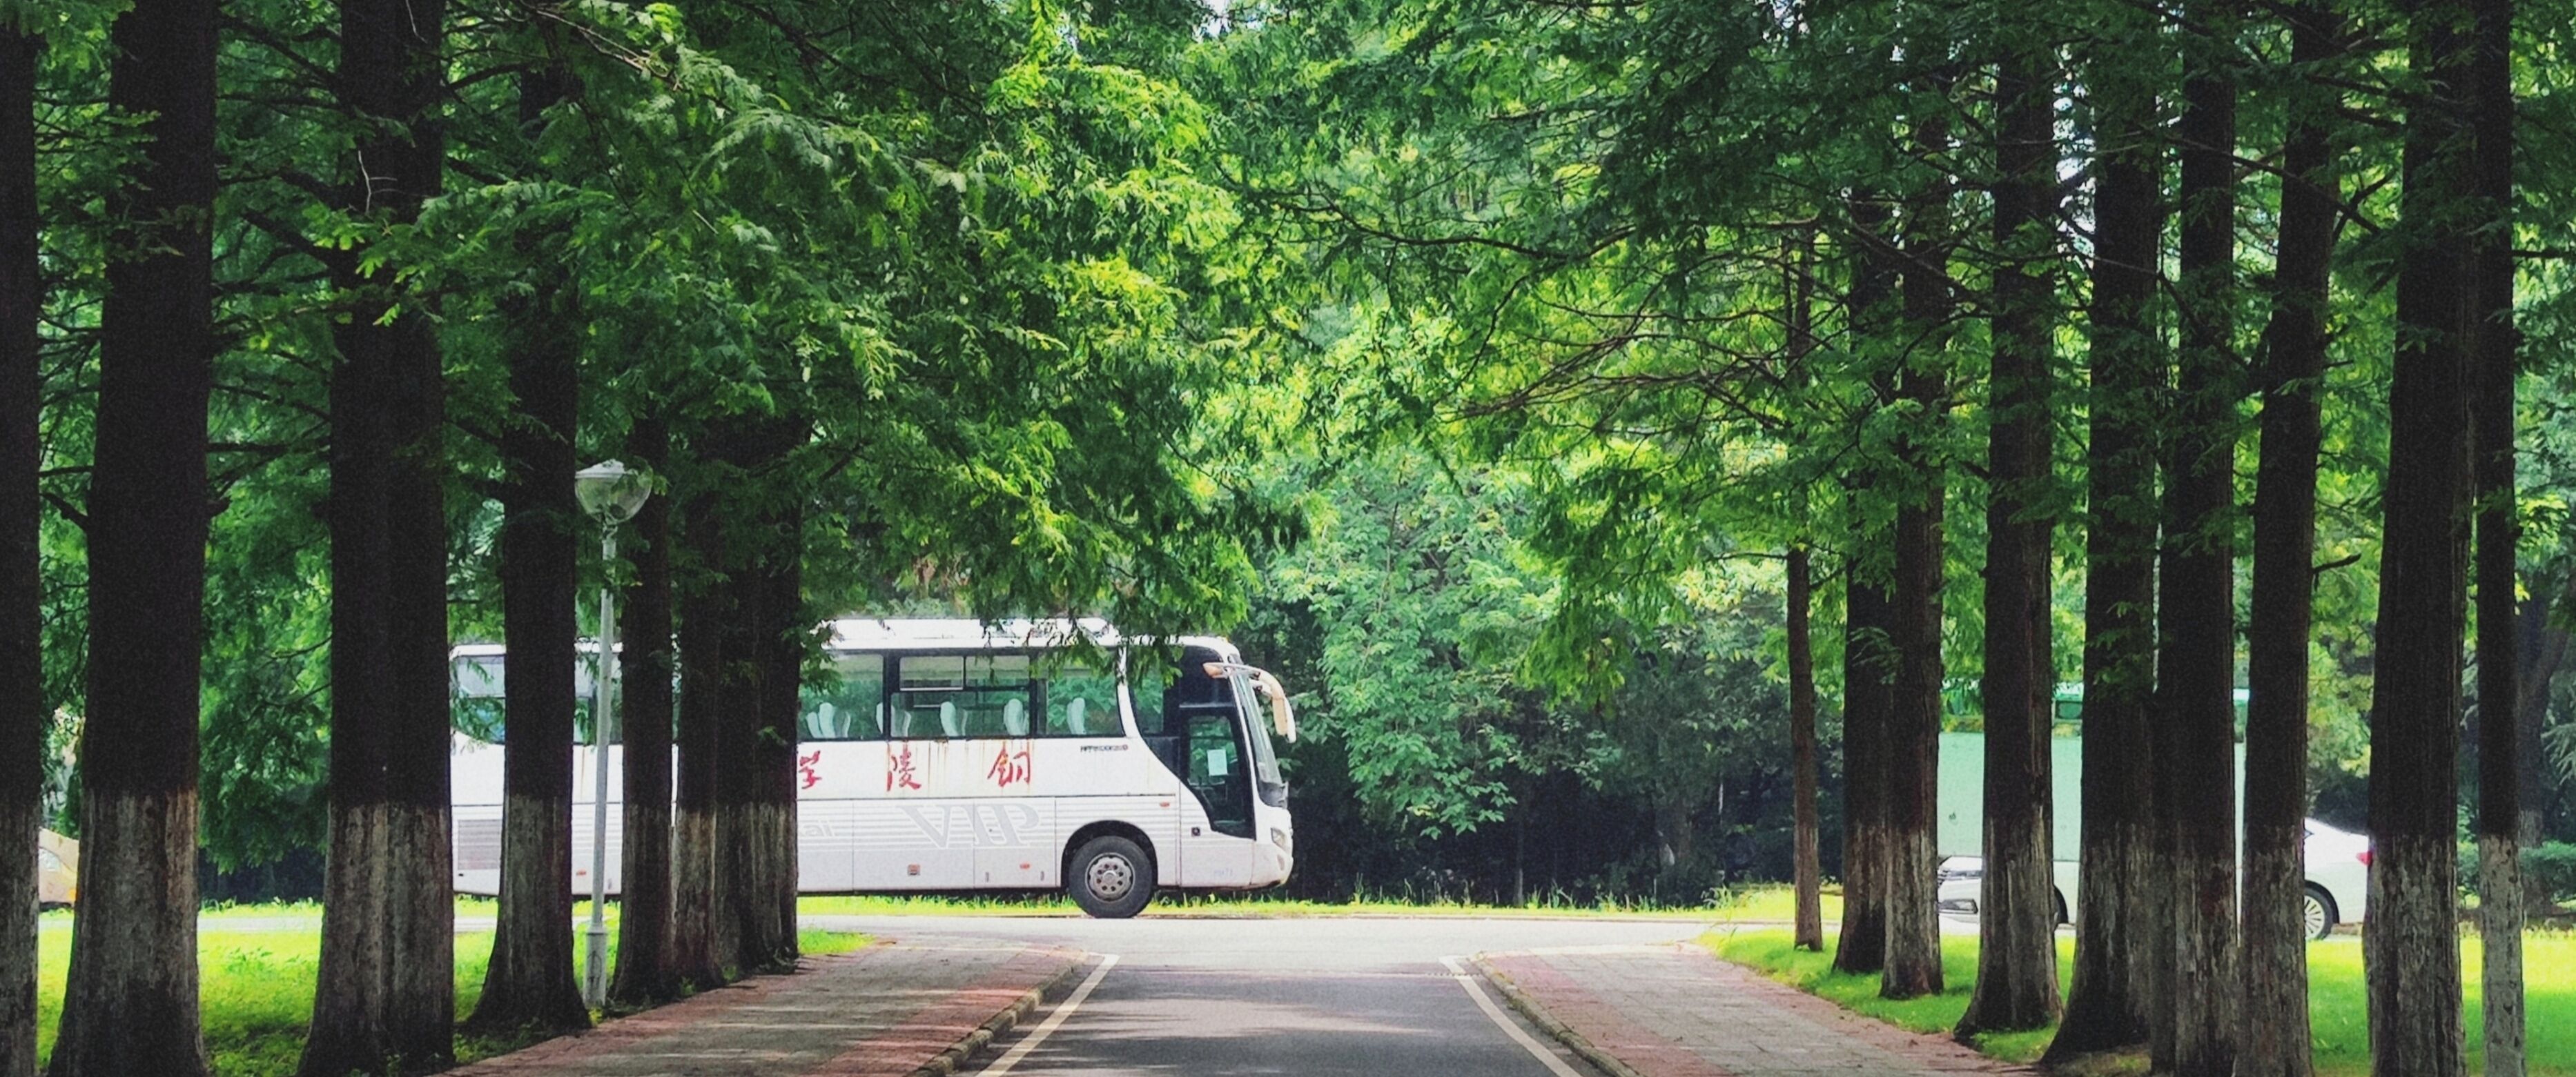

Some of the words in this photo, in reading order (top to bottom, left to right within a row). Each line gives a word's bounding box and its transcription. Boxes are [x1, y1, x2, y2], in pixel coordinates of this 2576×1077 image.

[887, 751, 922, 791] 陵
[987, 748, 1031, 787] 铜
[897, 802, 1040, 849] VIP
